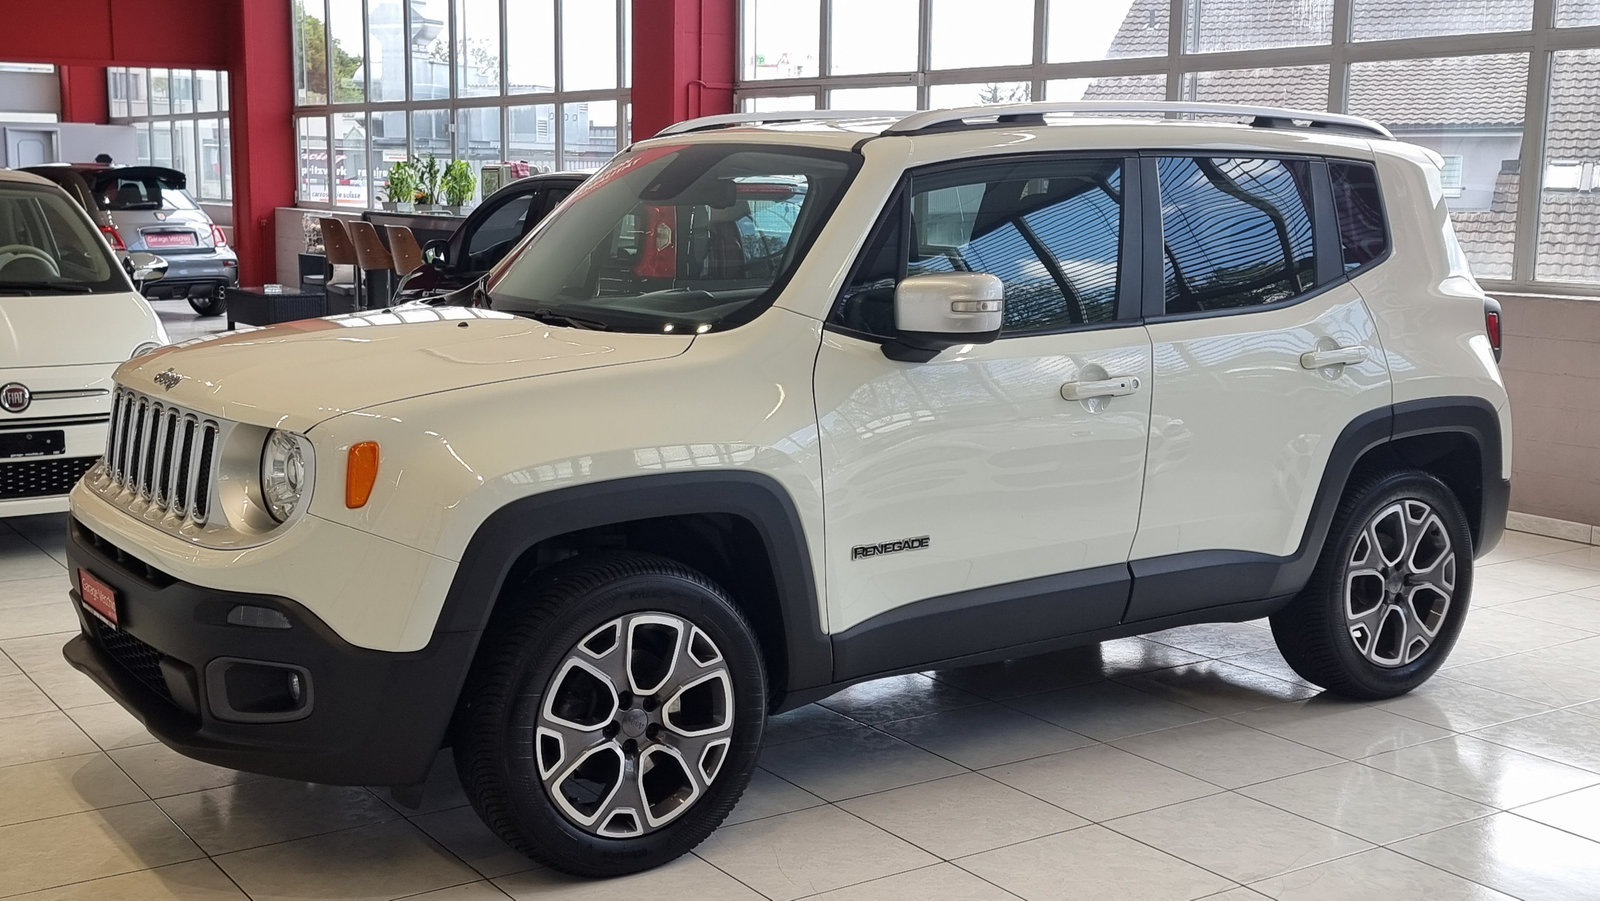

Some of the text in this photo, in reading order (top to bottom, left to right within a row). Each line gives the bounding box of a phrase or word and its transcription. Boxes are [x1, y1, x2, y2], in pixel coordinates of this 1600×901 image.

[147, 235, 168, 243] Garage
[7, 391, 24, 404] FIAT
[851, 535, 930, 561] RENEGADE
[81, 577, 99, 601] Garage
